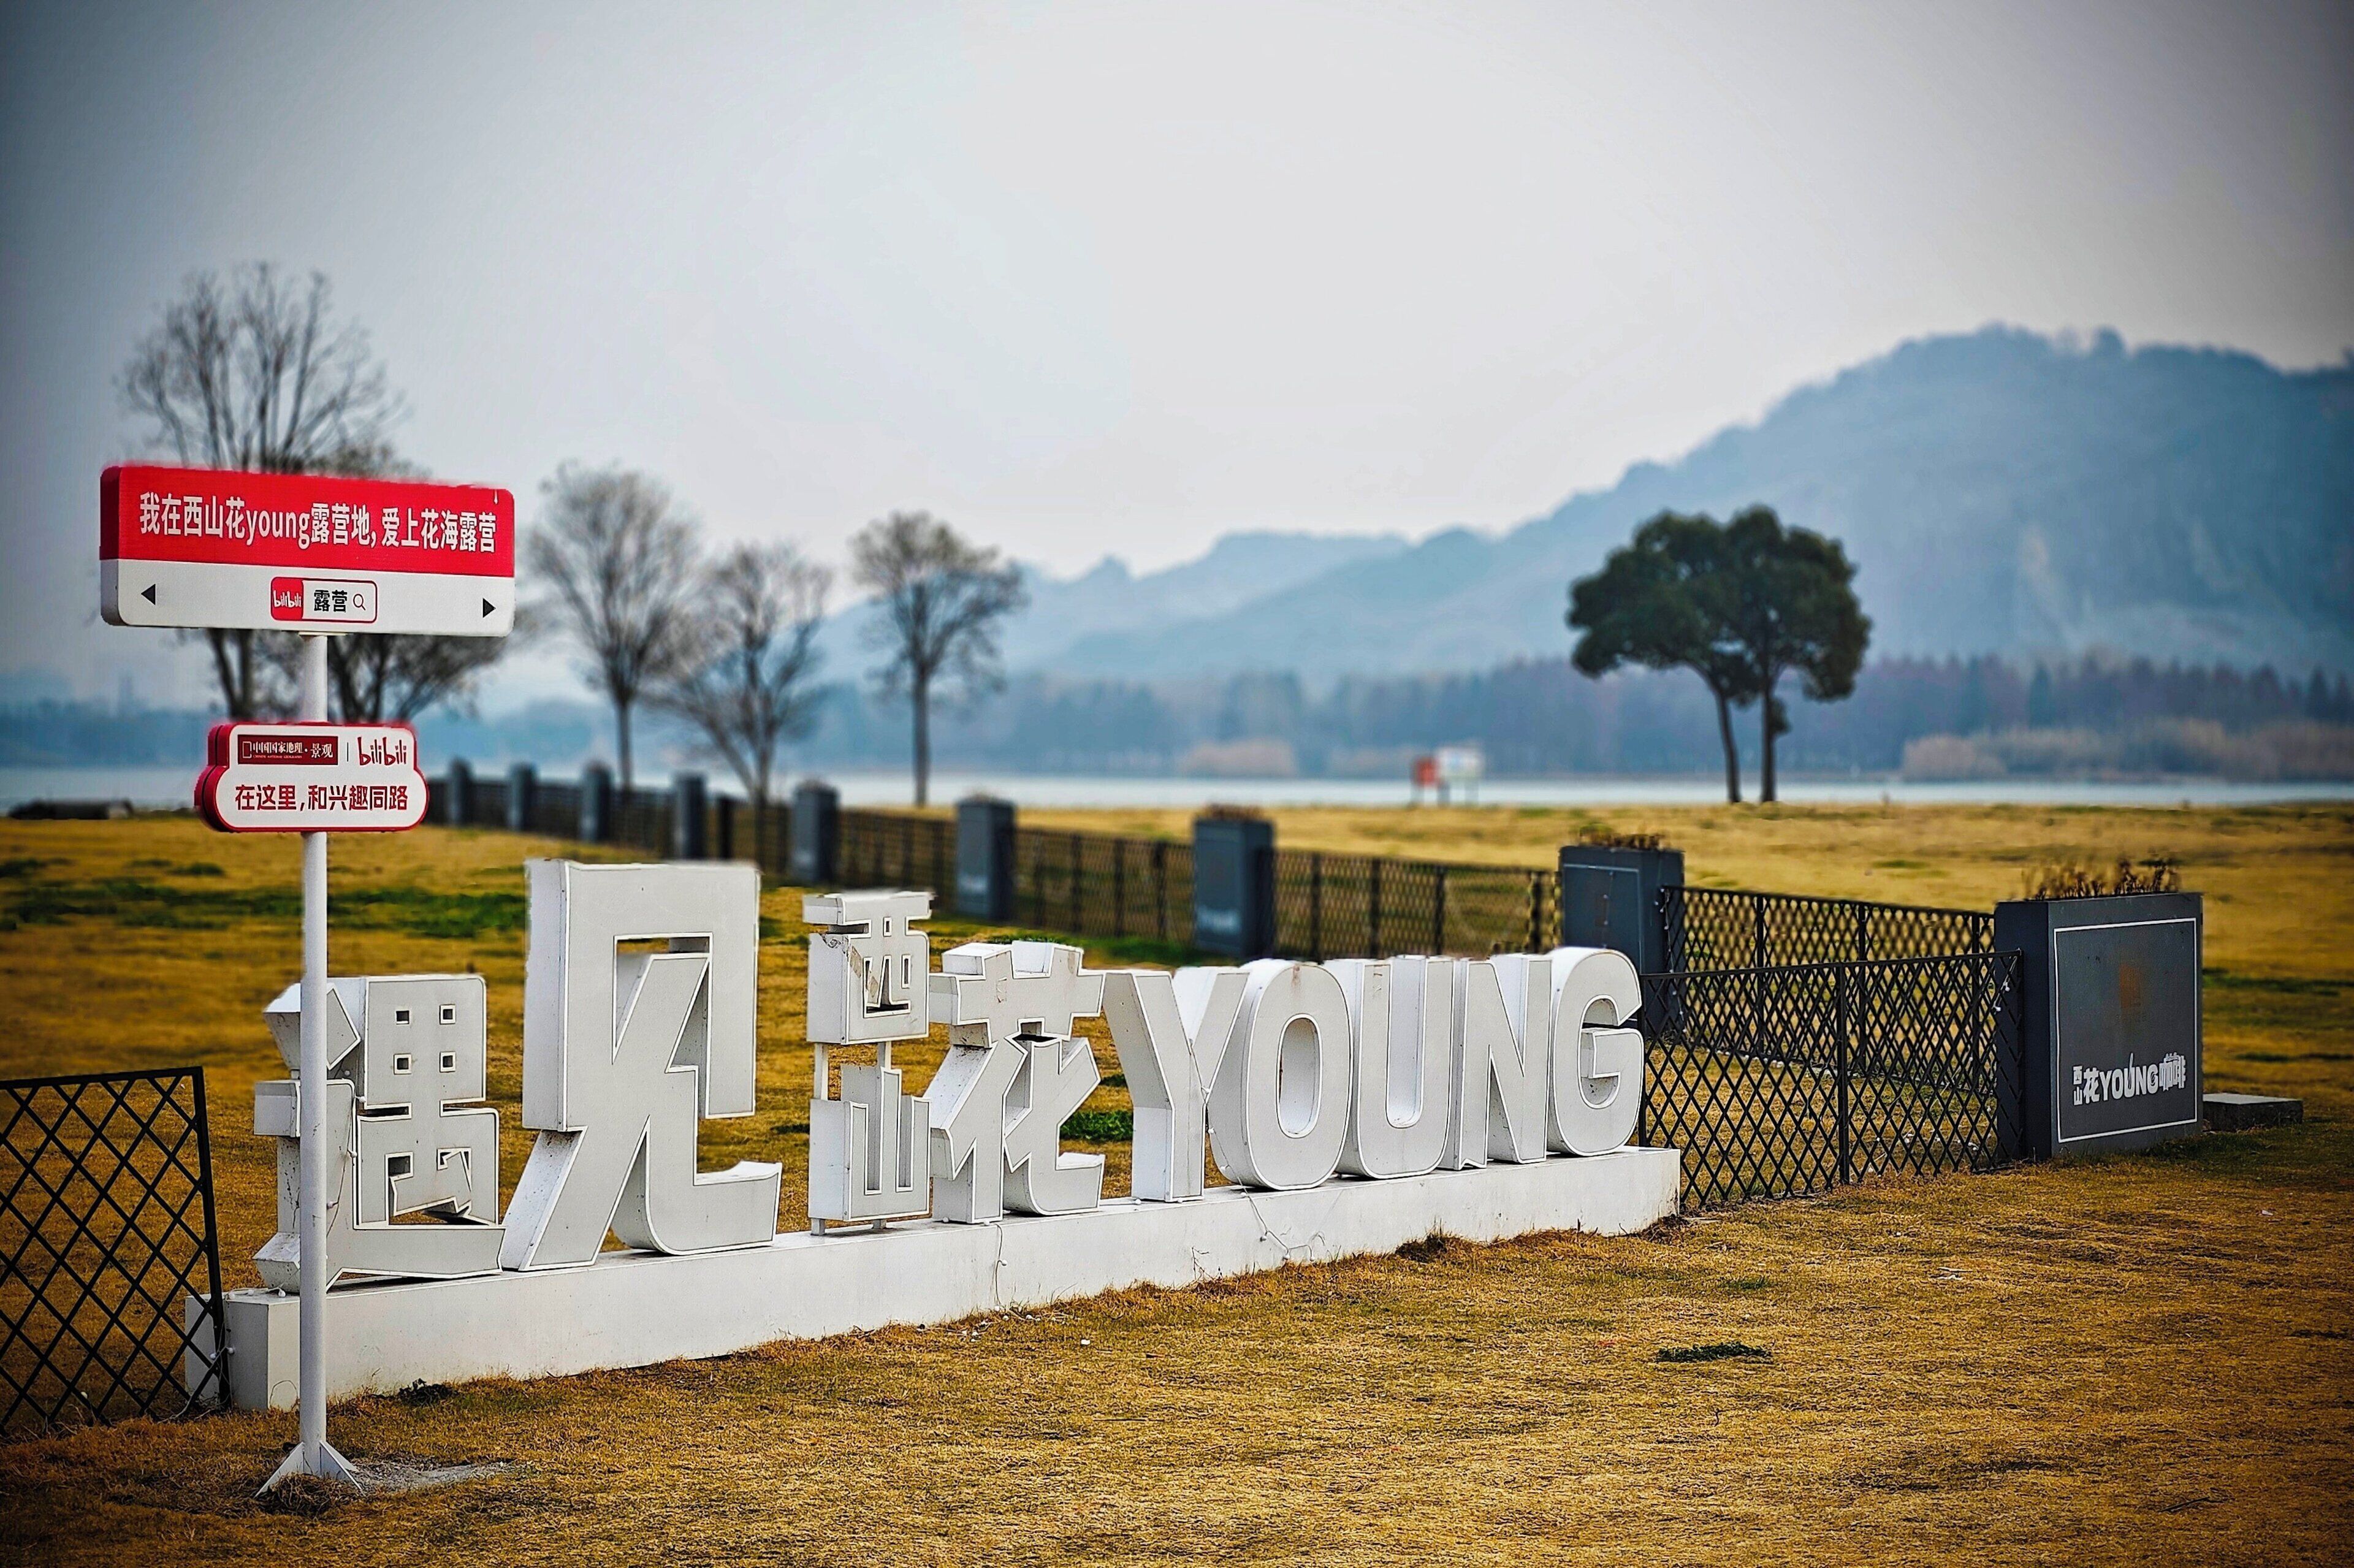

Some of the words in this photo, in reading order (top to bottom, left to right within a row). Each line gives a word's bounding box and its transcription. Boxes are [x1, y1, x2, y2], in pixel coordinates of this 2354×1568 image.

[273, 590, 302, 608] bilibili
[314, 589, 348, 612] 露营
[357, 736, 407, 766] bilibili
